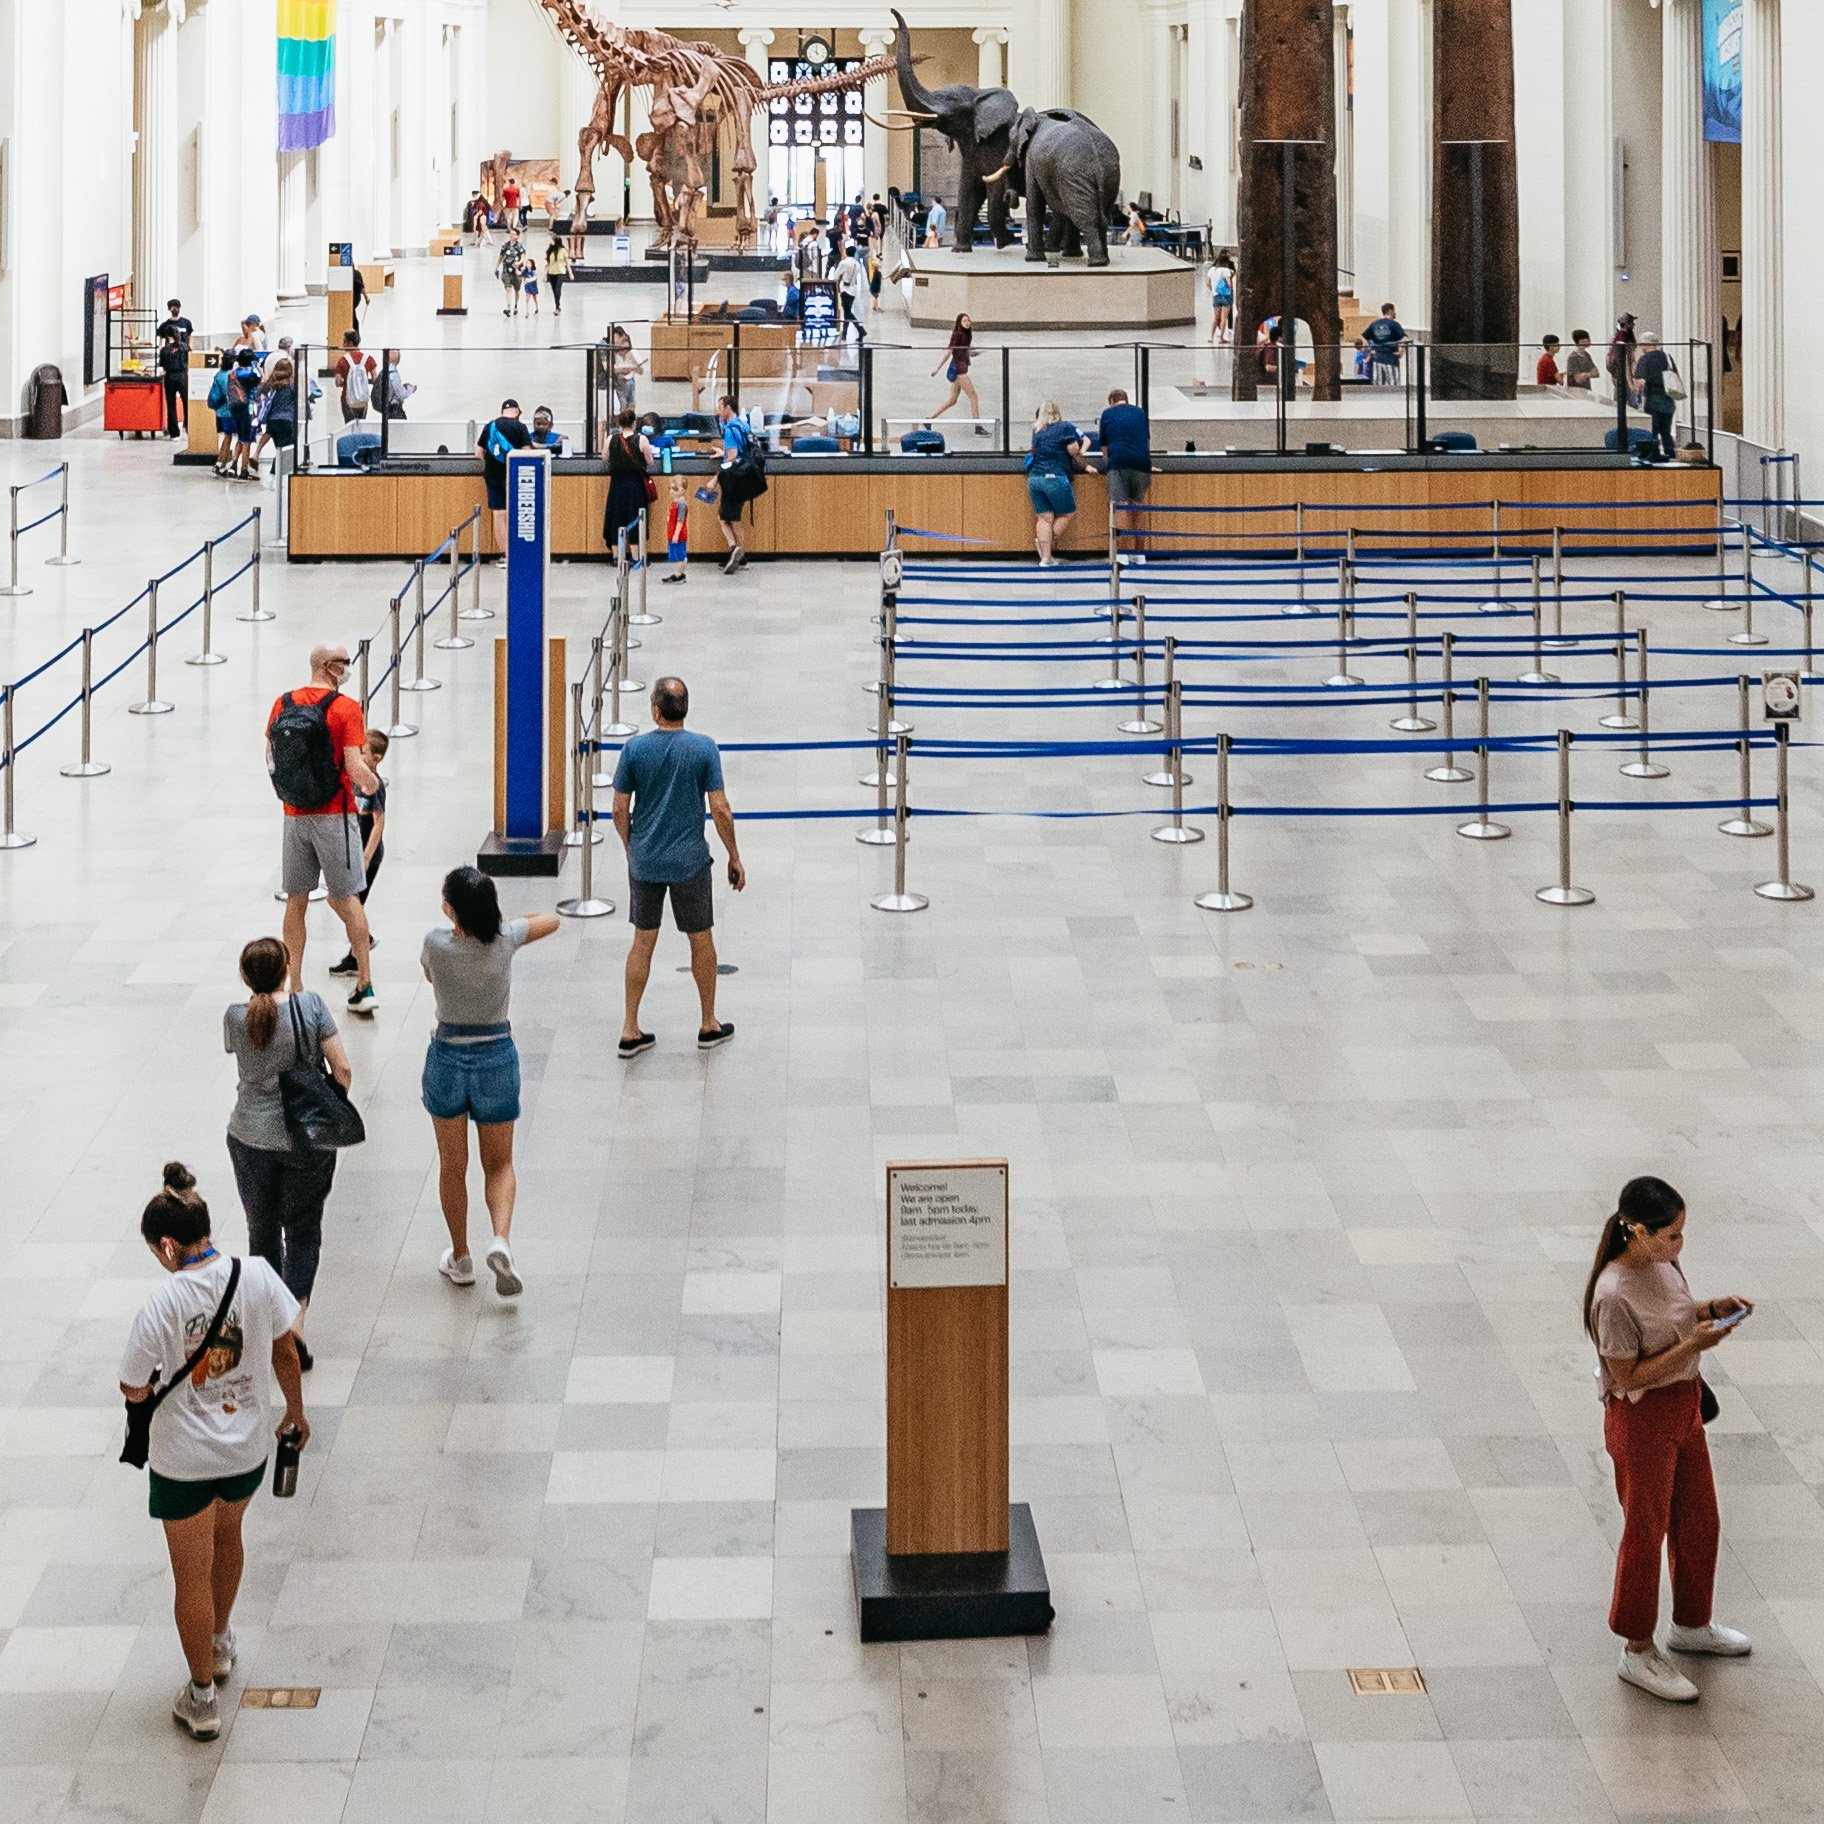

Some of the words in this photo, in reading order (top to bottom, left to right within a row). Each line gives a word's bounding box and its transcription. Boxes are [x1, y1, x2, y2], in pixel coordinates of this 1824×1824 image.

[518, 465, 536, 542] MEMBERSHIP
[900, 1182, 948, 1193] Welcome!
[900, 1194, 916, 1204] We
[918, 1195, 933, 1204] are
[935, 1194, 960, 1204] open
